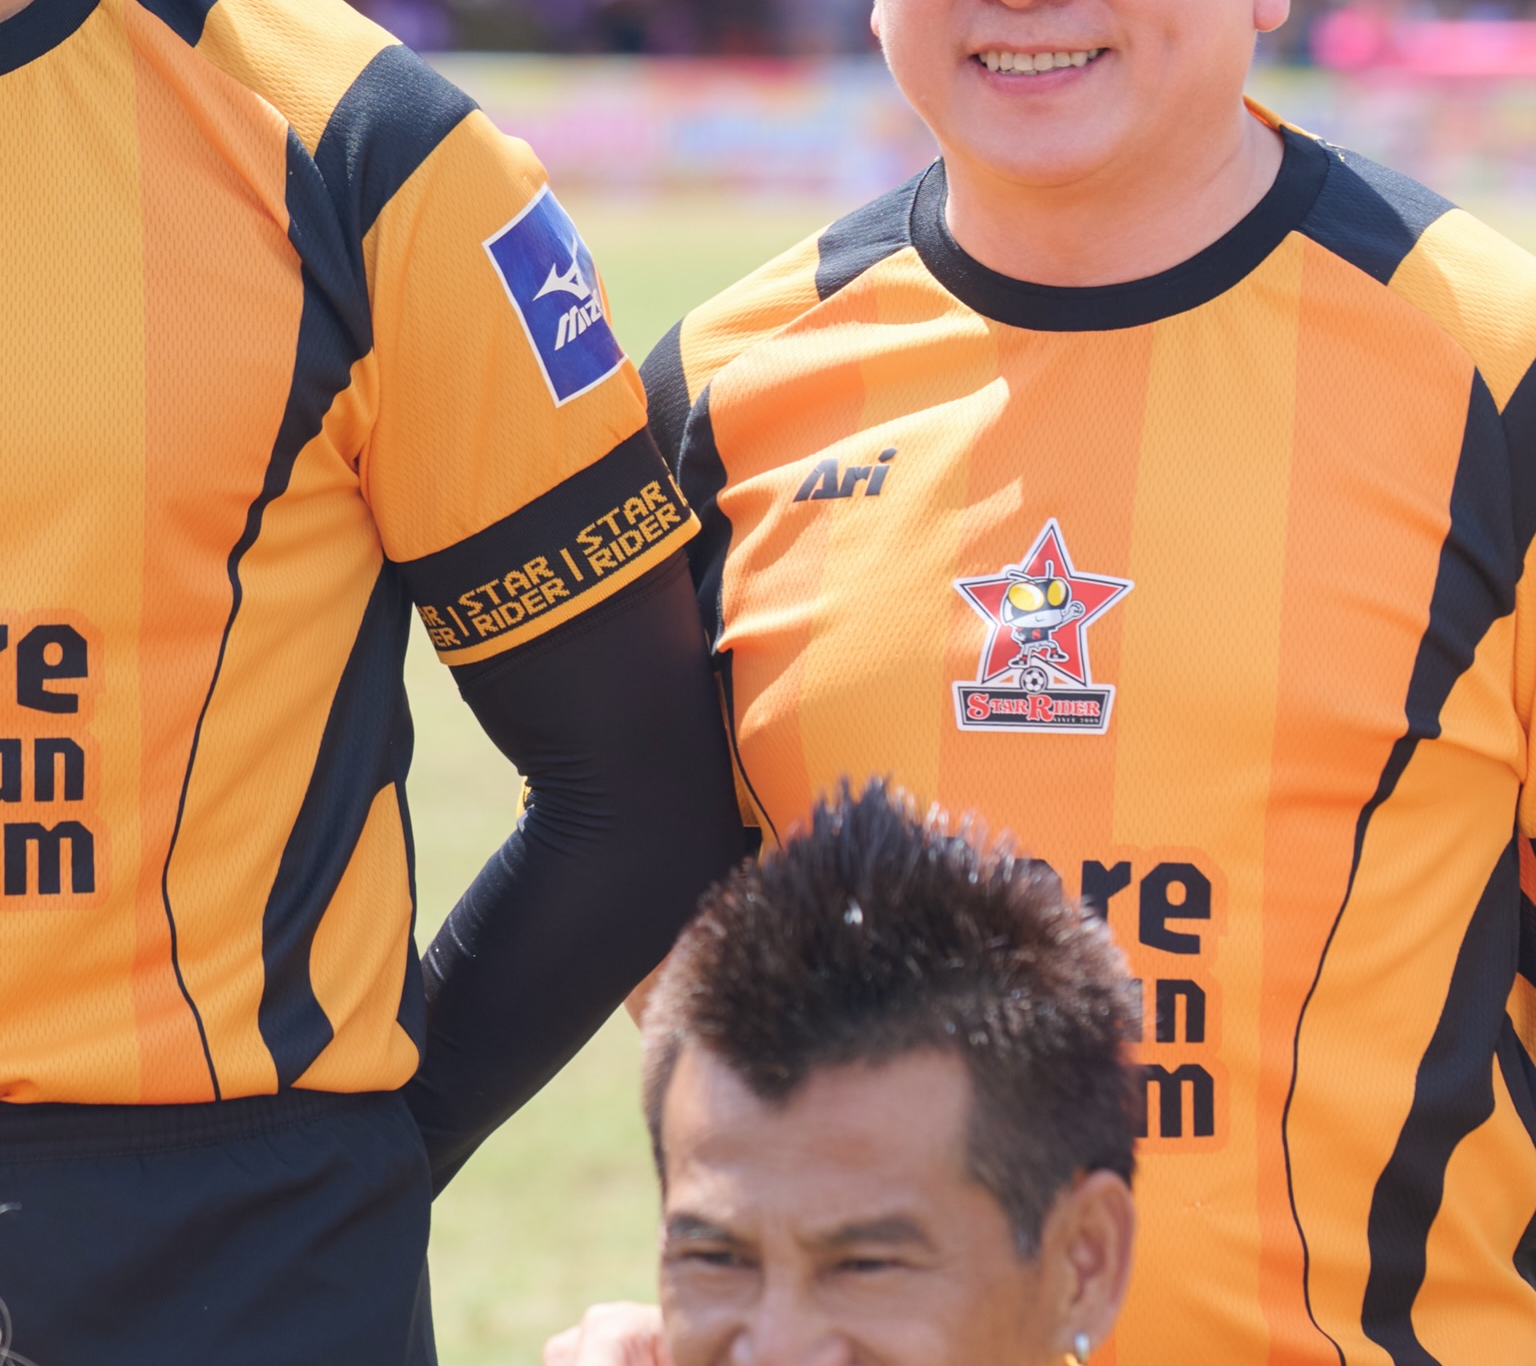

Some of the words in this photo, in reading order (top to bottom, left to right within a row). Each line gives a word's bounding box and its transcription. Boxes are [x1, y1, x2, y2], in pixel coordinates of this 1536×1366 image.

[794, 446, 899, 503] Ari
[575, 480, 668, 555] STAR
[587, 502, 681, 577] RIDER
[458, 555, 554, 618] STAR
[471, 578, 571, 638] RIDER
[1081, 860, 1211, 955] re
